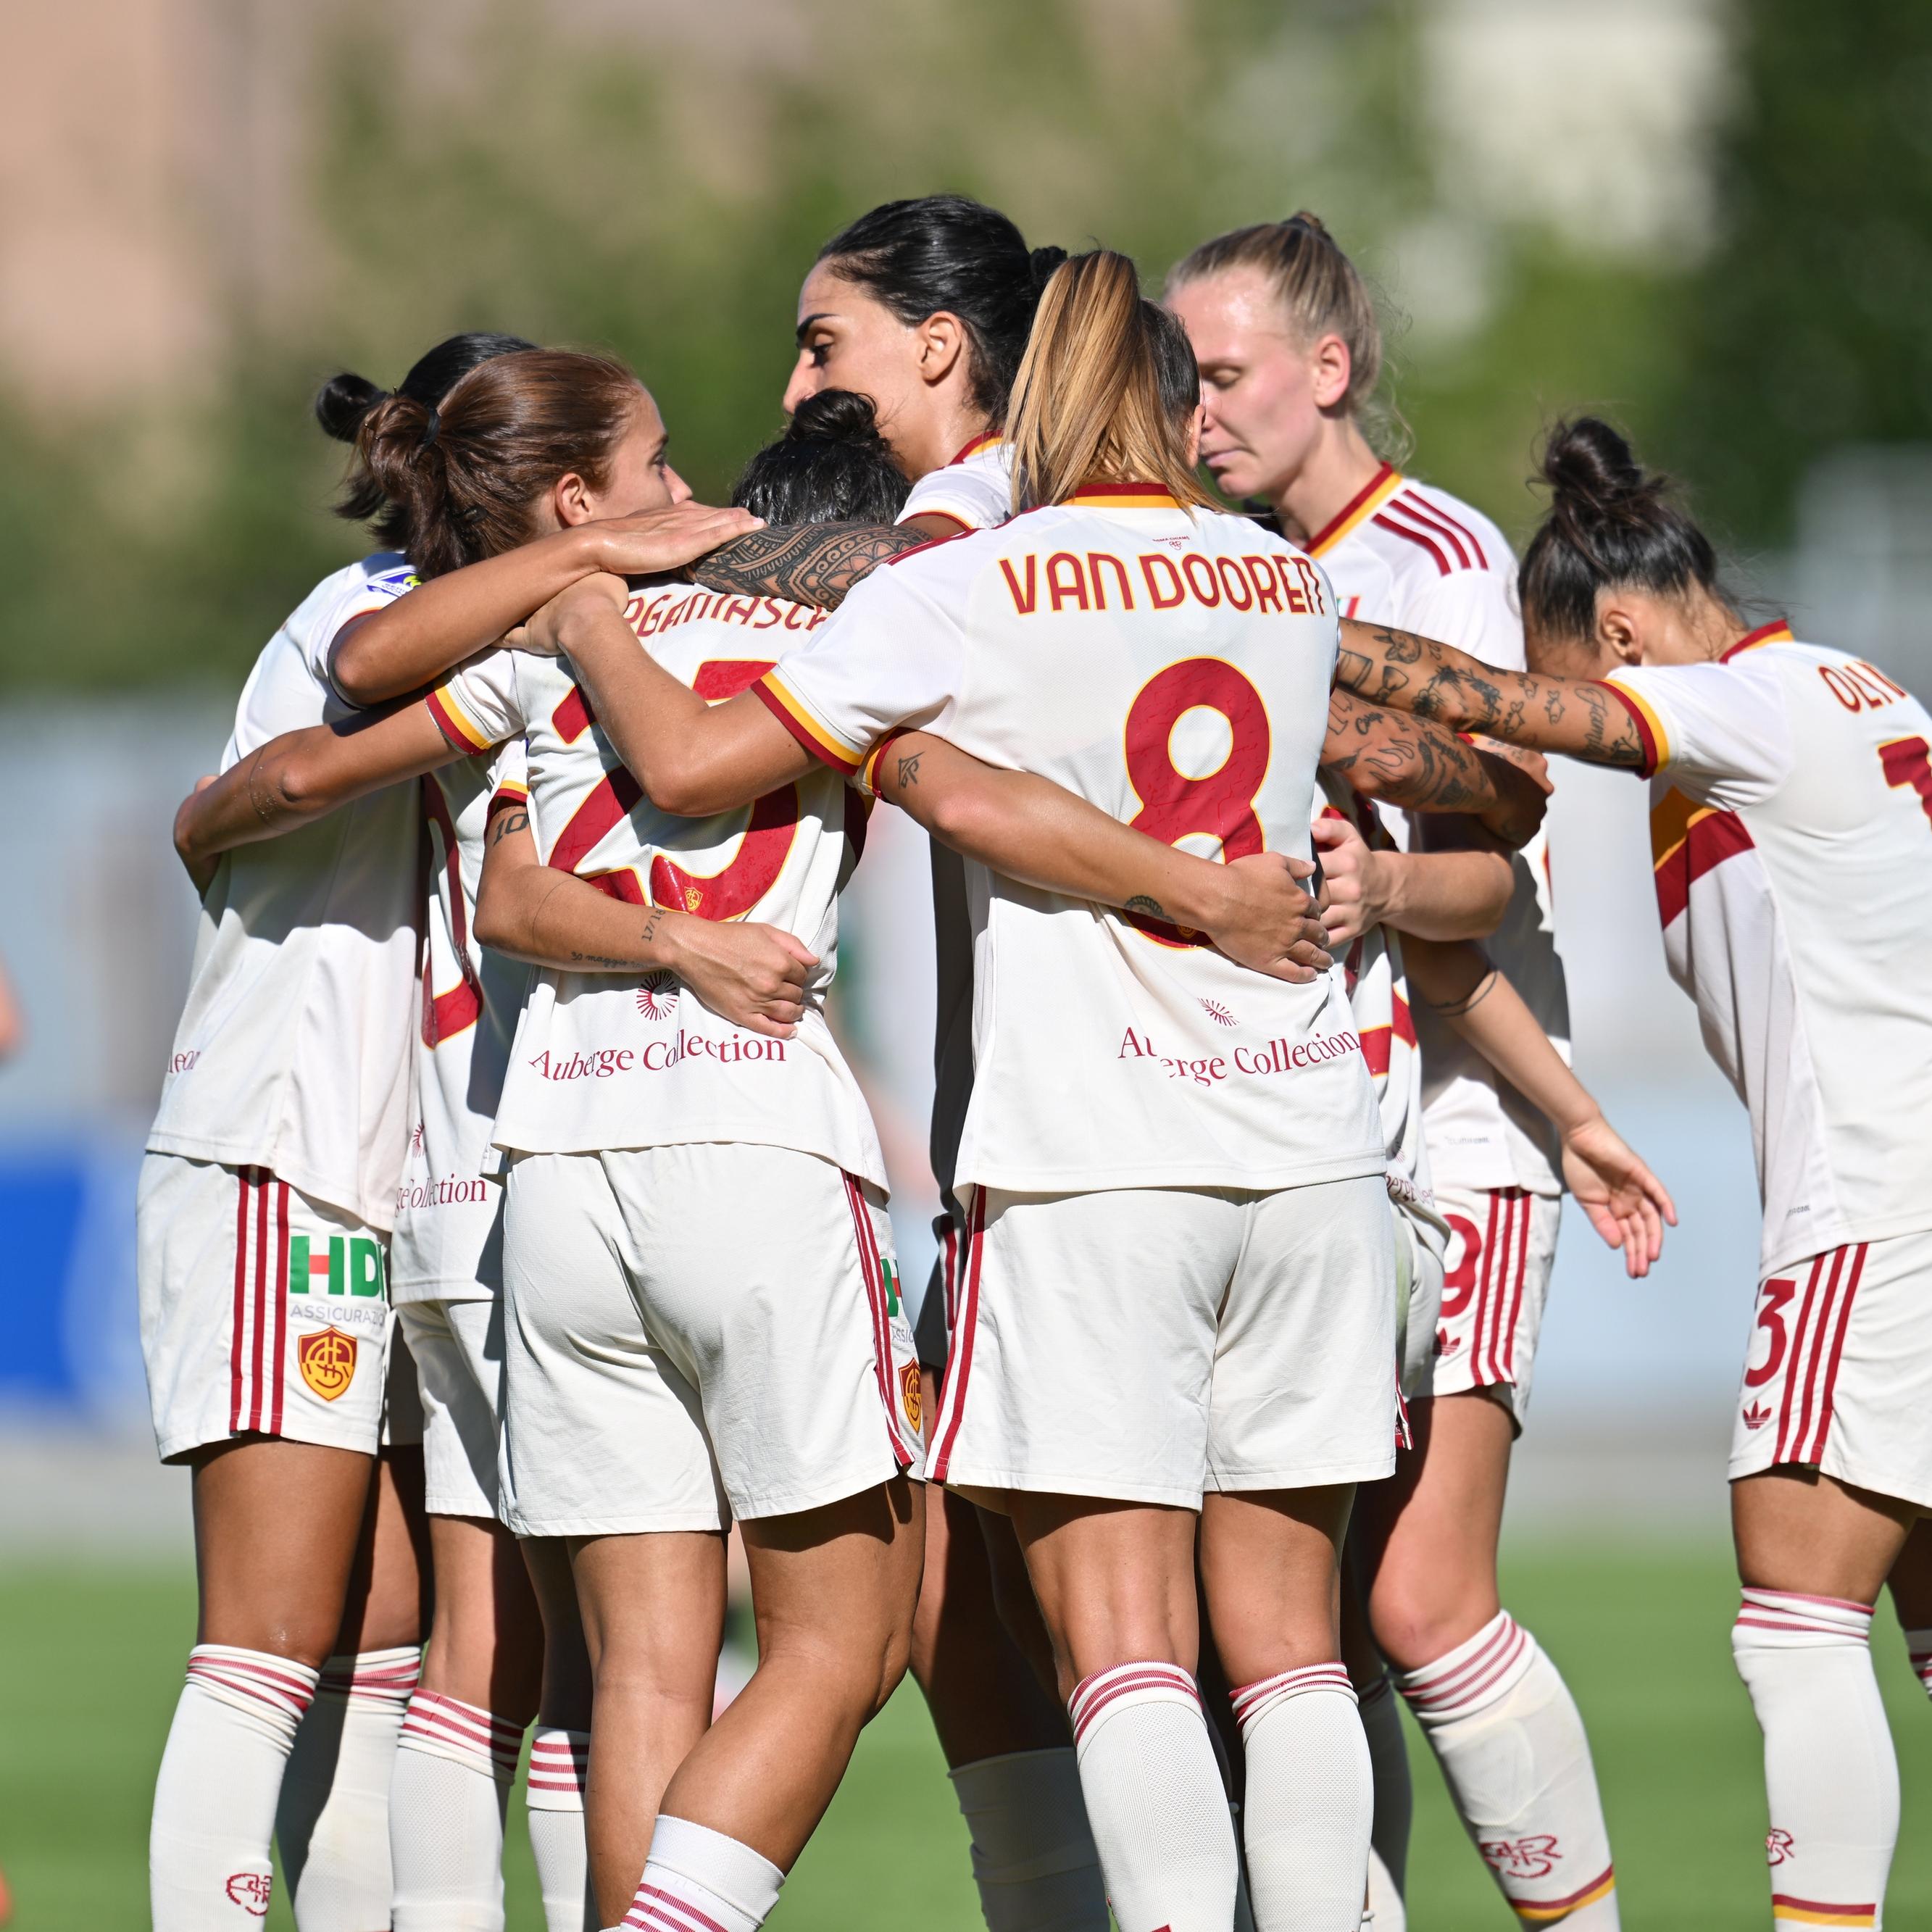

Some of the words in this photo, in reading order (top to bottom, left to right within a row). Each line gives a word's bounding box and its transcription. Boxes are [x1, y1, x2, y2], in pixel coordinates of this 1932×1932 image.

[999, 551, 1136, 615] VAN
[1138, 552, 1325, 615] DOOREN
[492, 812, 530, 847] 10
[1124, 655, 1272, 951] 8
[528, 1049, 634, 1081] Auberge
[642, 1028, 787, 1071] Collection
[1233, 1030, 1360, 1075] Collection
[410, 1173, 487, 1208] ollection
[1744, 1278, 1796, 1388] 3
